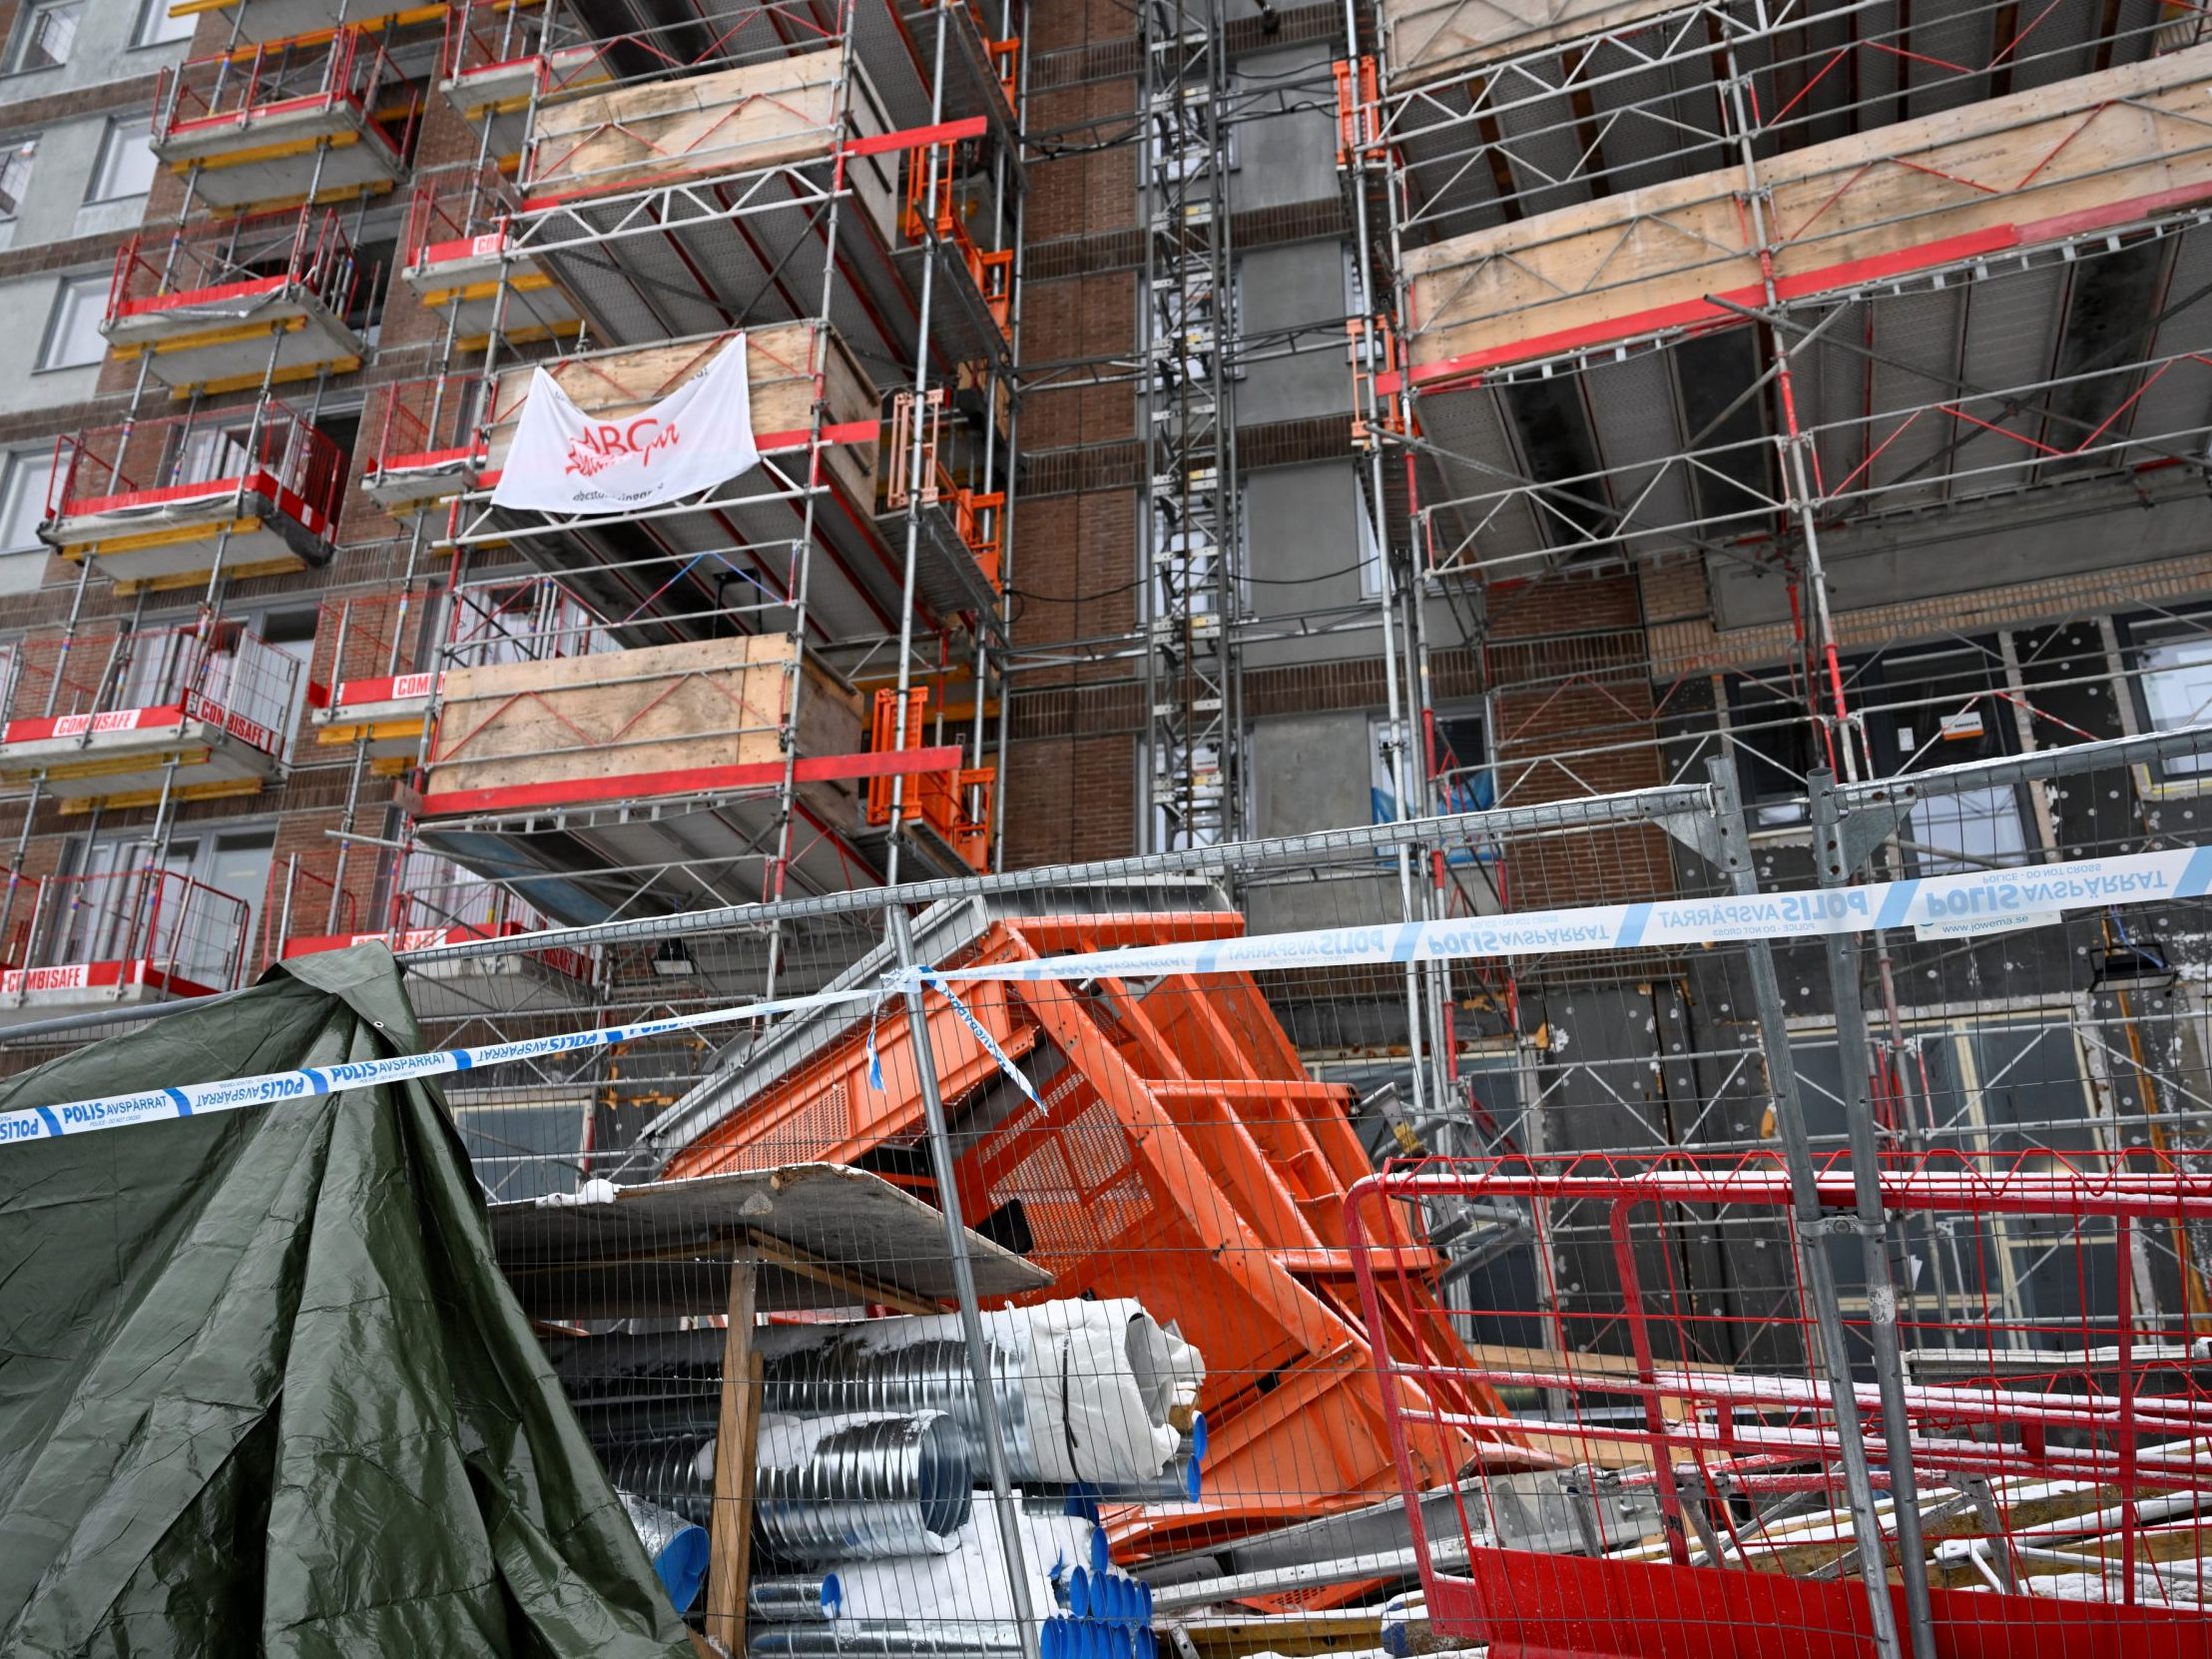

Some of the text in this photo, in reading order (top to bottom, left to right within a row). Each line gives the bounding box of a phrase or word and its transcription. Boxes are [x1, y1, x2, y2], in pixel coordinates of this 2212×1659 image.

[1942, 914, 2029, 932] www.jowema.se
[329, 1062, 378, 1082] POLIS
[260, 1077, 304, 1100] POLIS
[62, 1095, 167, 1124] POLIS AVSPÄRRAT
[0, 1118, 39, 1141] POLIS
